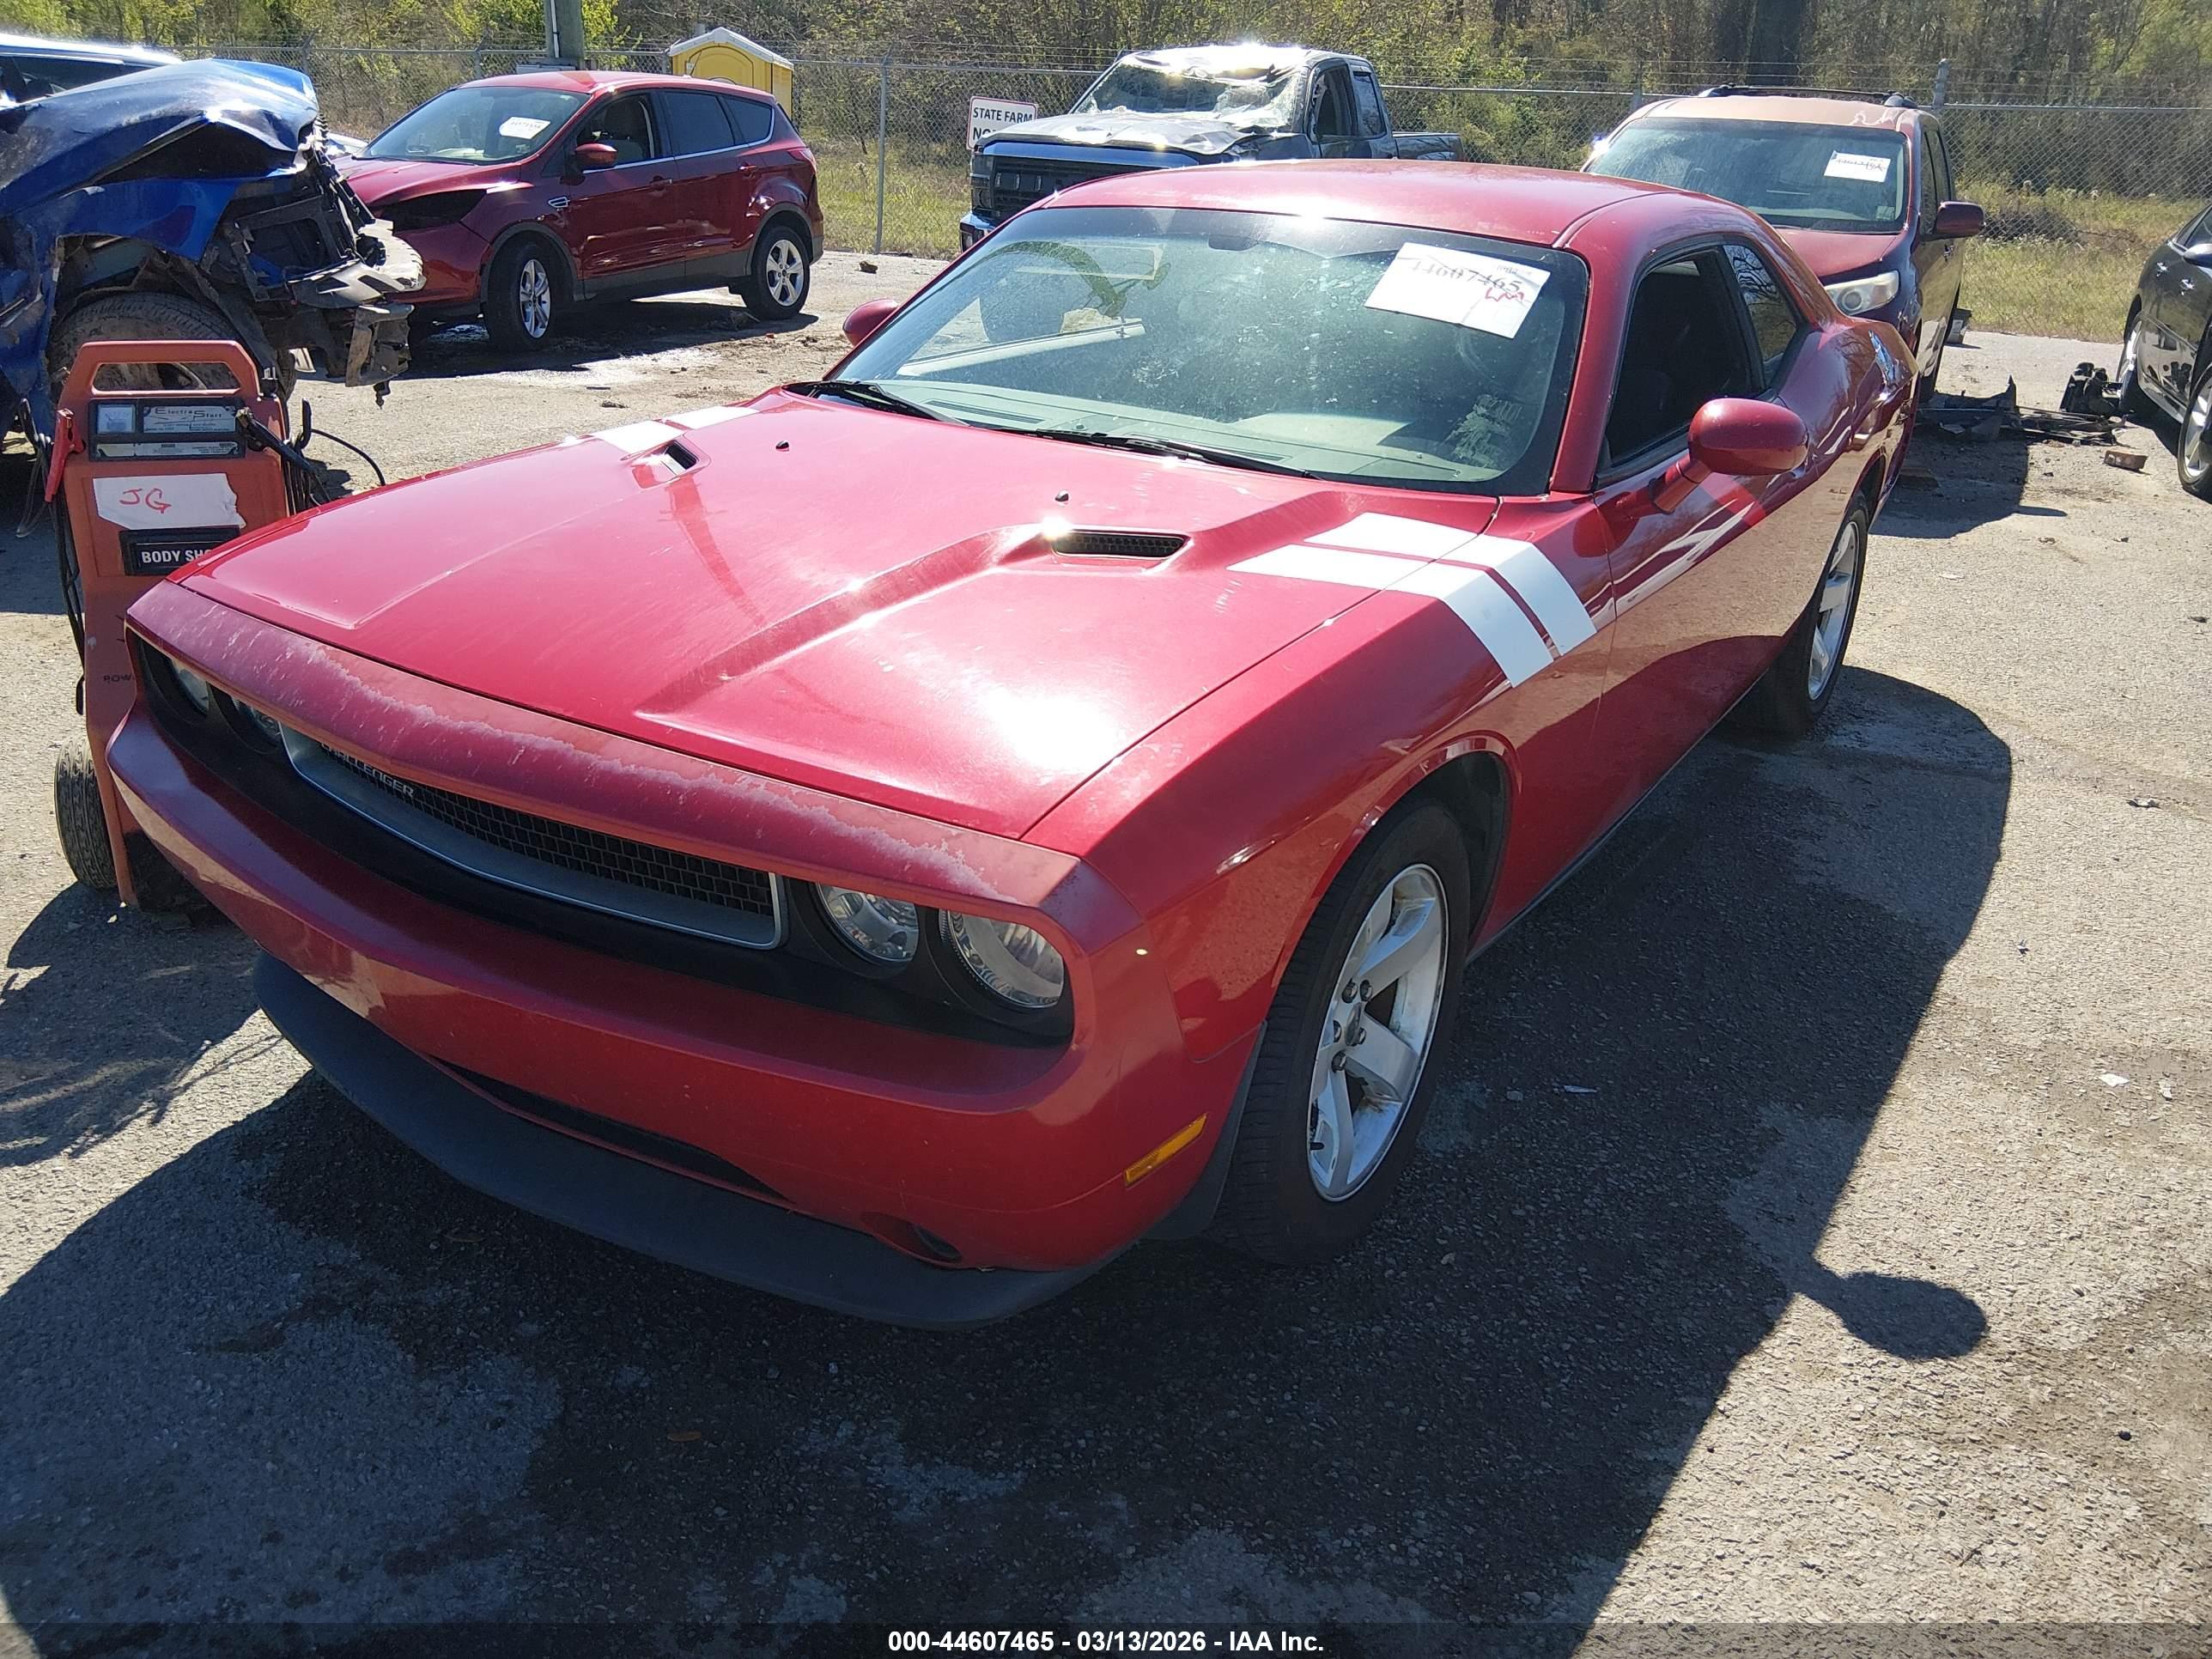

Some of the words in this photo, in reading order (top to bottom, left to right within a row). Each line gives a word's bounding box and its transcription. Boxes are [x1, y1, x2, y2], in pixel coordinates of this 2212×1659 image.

[973, 107, 1002, 121] STATE
[1005, 111, 1032, 124] FARM
[119, 488, 172, 514] JG
[141, 550, 181, 563] BODY
